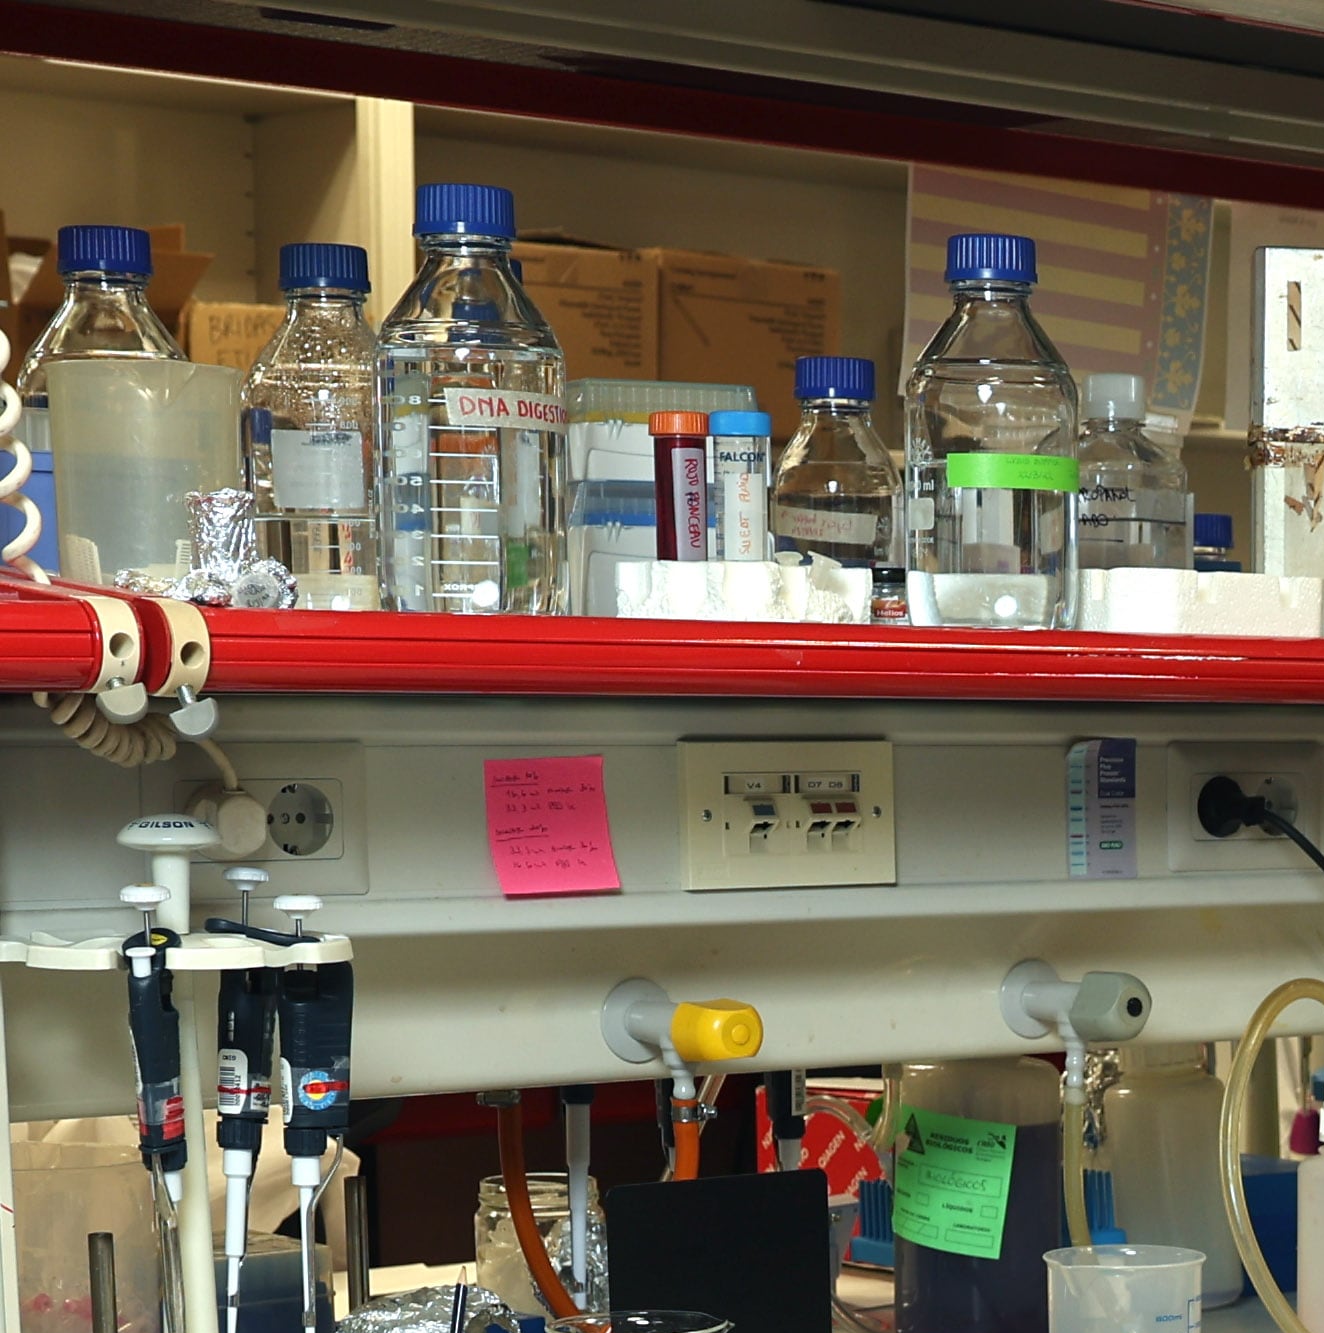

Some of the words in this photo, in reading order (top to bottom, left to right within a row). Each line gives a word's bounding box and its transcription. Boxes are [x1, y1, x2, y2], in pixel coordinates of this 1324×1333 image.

[459, 395, 510, 417] DNA
[719, 451, 764, 463] FALCON
[138, 821, 195, 829] GILSON
